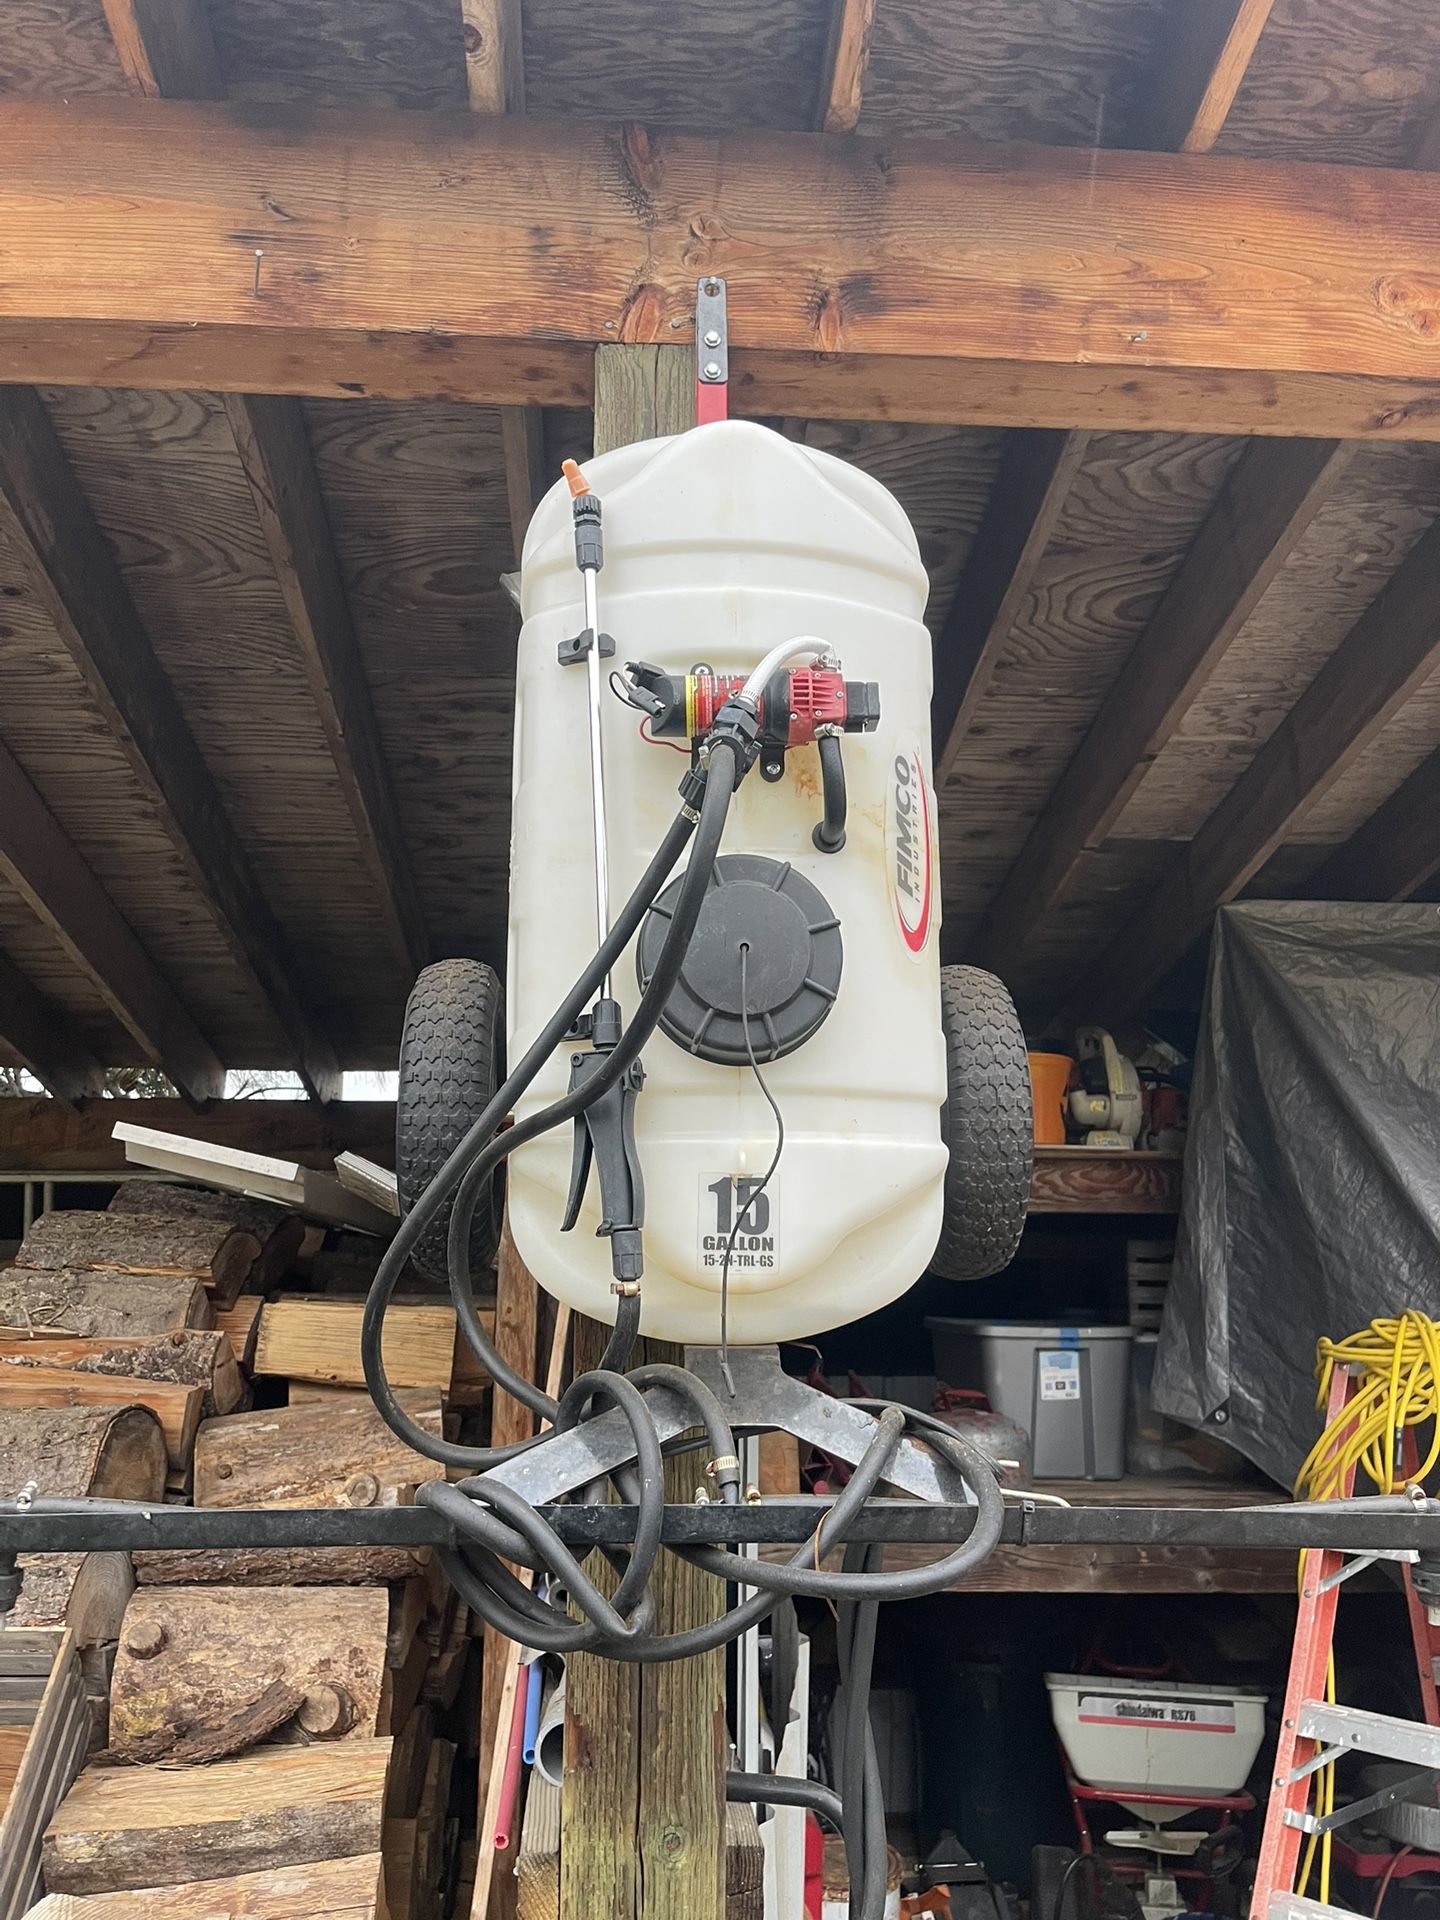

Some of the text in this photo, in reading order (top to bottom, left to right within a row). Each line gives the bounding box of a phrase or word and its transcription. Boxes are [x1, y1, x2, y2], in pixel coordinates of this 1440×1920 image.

[894, 755, 914, 898] FIMCO
[911, 762, 920, 903] INDUSTRIES
[702, 1236, 774, 1251] GALLON
[708, 1177, 770, 1235] 15
